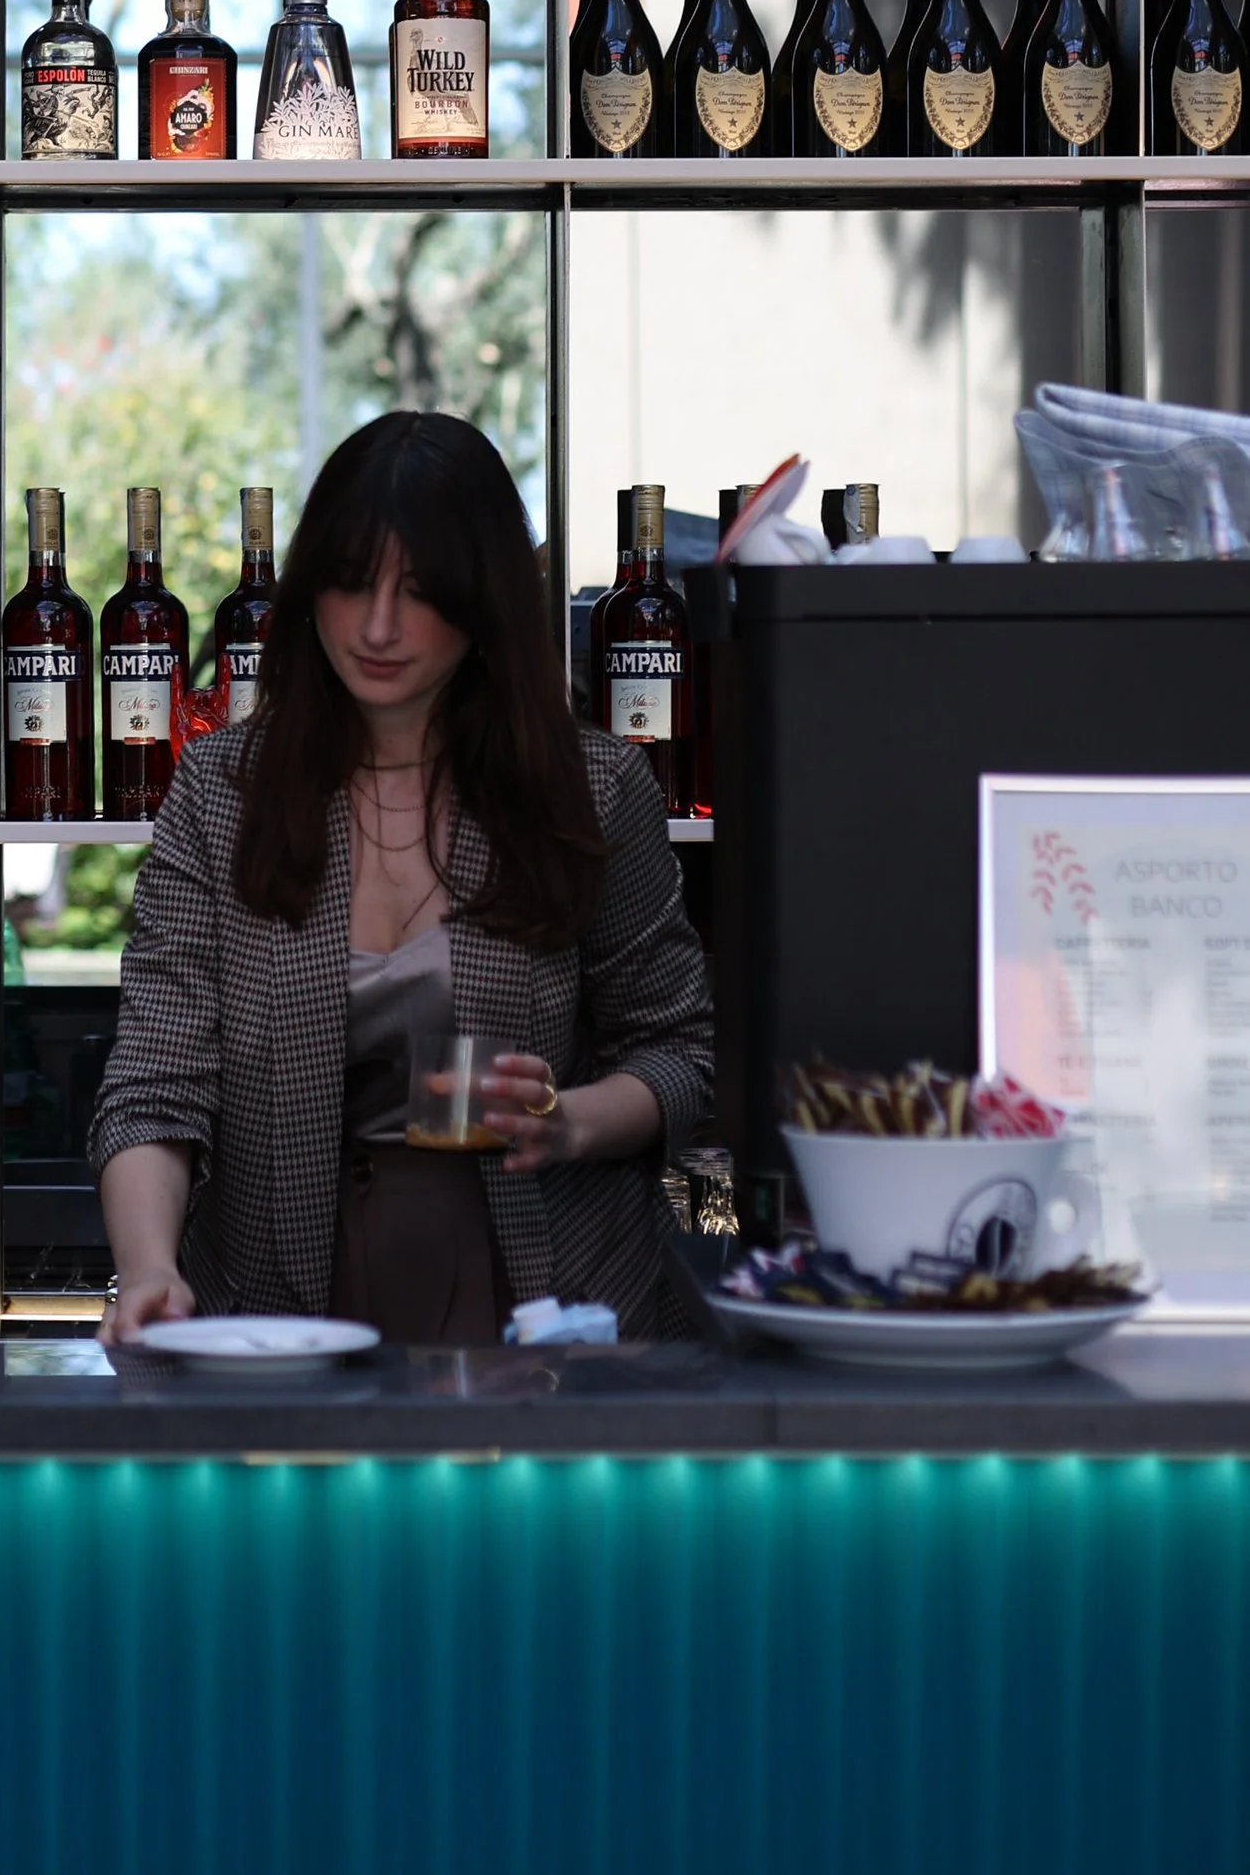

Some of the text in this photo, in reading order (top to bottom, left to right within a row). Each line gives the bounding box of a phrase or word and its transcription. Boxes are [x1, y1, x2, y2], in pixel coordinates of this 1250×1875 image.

[416, 49, 466, 70] WILD
[407, 68, 475, 93] TURKEY
[415, 100, 468, 109] BOURBON
[175, 112, 202, 124] AMARO
[278, 125, 358, 139] GIN MARE
[606, 653, 681, 673] CAMPARI
[1114, 860, 1238, 884] ASPORTO
[1130, 896, 1223, 919] BANCO
